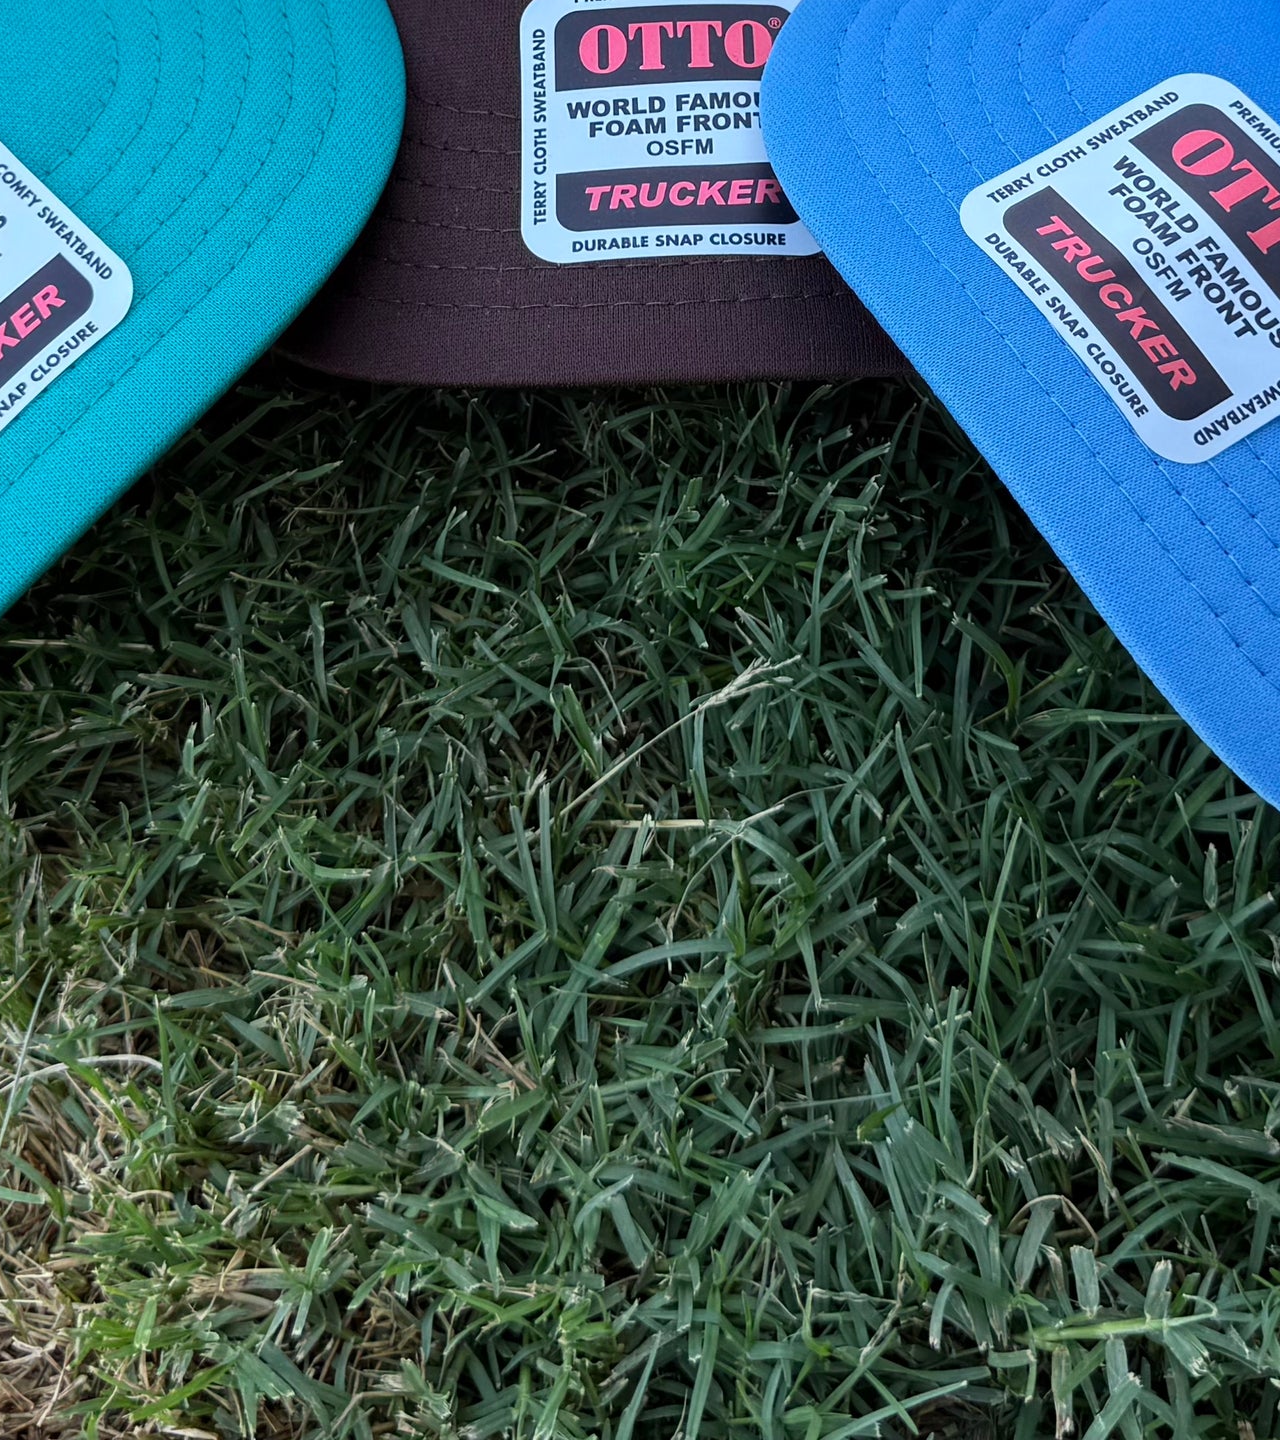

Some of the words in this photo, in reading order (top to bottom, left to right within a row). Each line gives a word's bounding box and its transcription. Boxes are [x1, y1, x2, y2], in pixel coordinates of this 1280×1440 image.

[533, 29, 547, 122] SWEATBAND
[567, 96, 666, 119] WORLD
[676, 92, 760, 110] FAMO
[534, 124, 547, 176] CLOTH
[589, 117, 666, 137] FOAM
[646, 138, 714, 156] OSFM
[986, 173, 1034, 204] TERRY
[1037, 146, 1087, 178] CLOTH
[1087, 91, 1179, 151] SWEATBAND
[534, 181, 547, 225] TERRY
[584, 178, 781, 211] TRUCKER
[1112, 155, 1199, 234] WORLD
[37, 206, 113, 281] SWEATBAND
[572, 236, 649, 253] DURABLE
[655, 235, 703, 247] SNAP
[709, 233, 786, 245] CLOSURE
[1107, 182, 1181, 247] FOAM
[1176, 245, 1257, 340] FRONT
[1132, 237, 1192, 302] OSFM
[985, 233, 1049, 296] DURABLE
[1045, 295, 1088, 338] SNAP
[1087, 343, 1149, 418] CLOSURE
[1035, 216, 1198, 391] TRUCKER
[31, 321, 99, 383] CLOSURE
